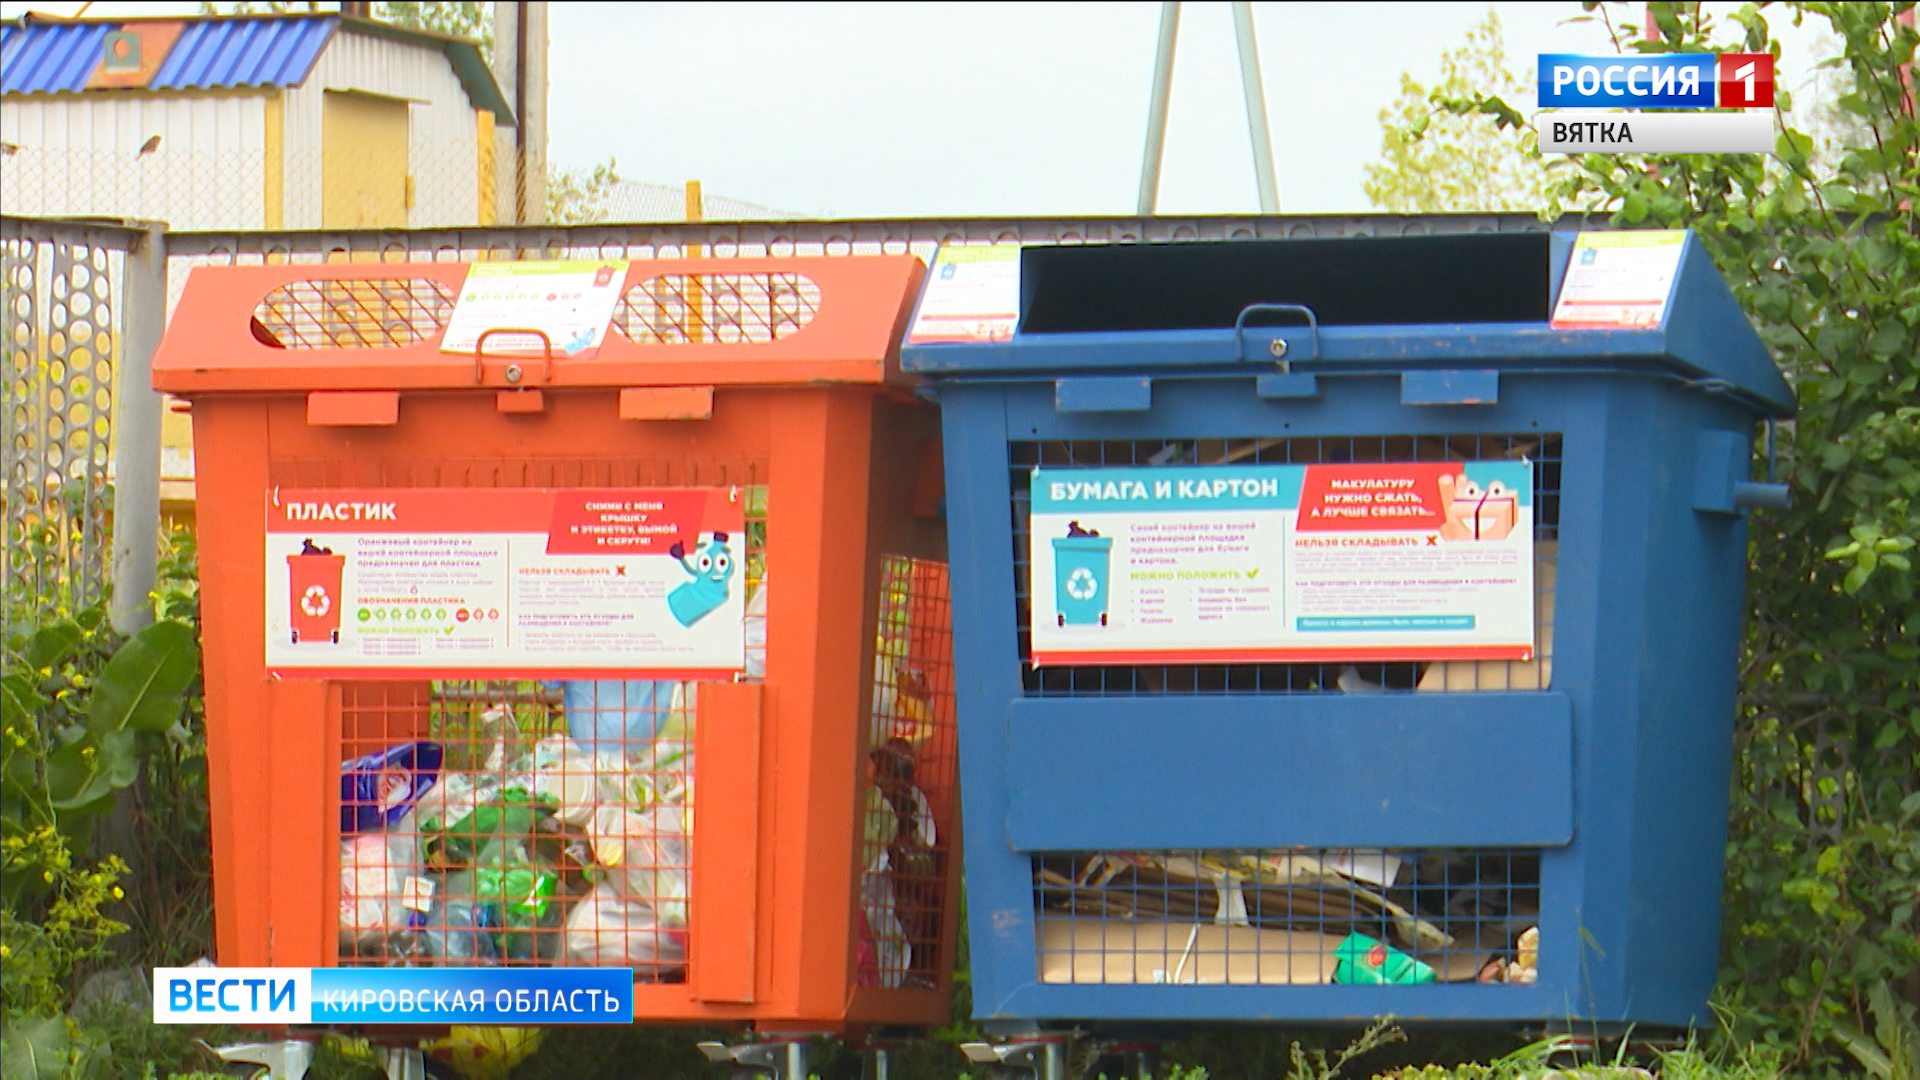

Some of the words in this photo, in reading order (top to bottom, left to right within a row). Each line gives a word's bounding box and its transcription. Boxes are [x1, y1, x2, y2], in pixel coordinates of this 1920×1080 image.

[1050, 481, 1148, 500] БУМАГА
[1155, 481, 1171, 498] И
[1178, 478, 1278, 498] КАРТОН
[1331, 479, 1415, 489] МАКУЛАТУРУ
[1324, 493, 1372, 503] НУЖНО
[1375, 492, 1422, 503] СЖАТЬ,
[286, 502, 397, 520] ПЛАСТИК
[585, 502, 623, 511] СНИМИ
[625, 502, 632, 511] С
[634, 502, 664, 511] МЕНЯ
[1311, 508, 1320, 517] А
[1323, 507, 1369, 517] ЛУЧШЕ
[600, 514, 648, 523] КРЫШКУ
[570, 525, 579, 533] И
[581, 525, 637, 535] ЭТИКЕТКУ,
[637, 523, 678, 534] ВЫМОЙ
[597, 536, 606, 545] И
[607, 536, 651, 545] СКРУТИ!
[1295, 538, 1339, 547] НЕЛЬЗЯ
[1341, 536, 1419, 547] СКЛАДЫВАТЬ
[518, 567, 551, 575] НЕЛЬЗЯ
[553, 567, 611, 576] СКЛАДЫВАТЬ
[1130, 571, 1174, 580] МОЖНО
[1177, 570, 1241, 580] ПОЛОЖИТЬ
